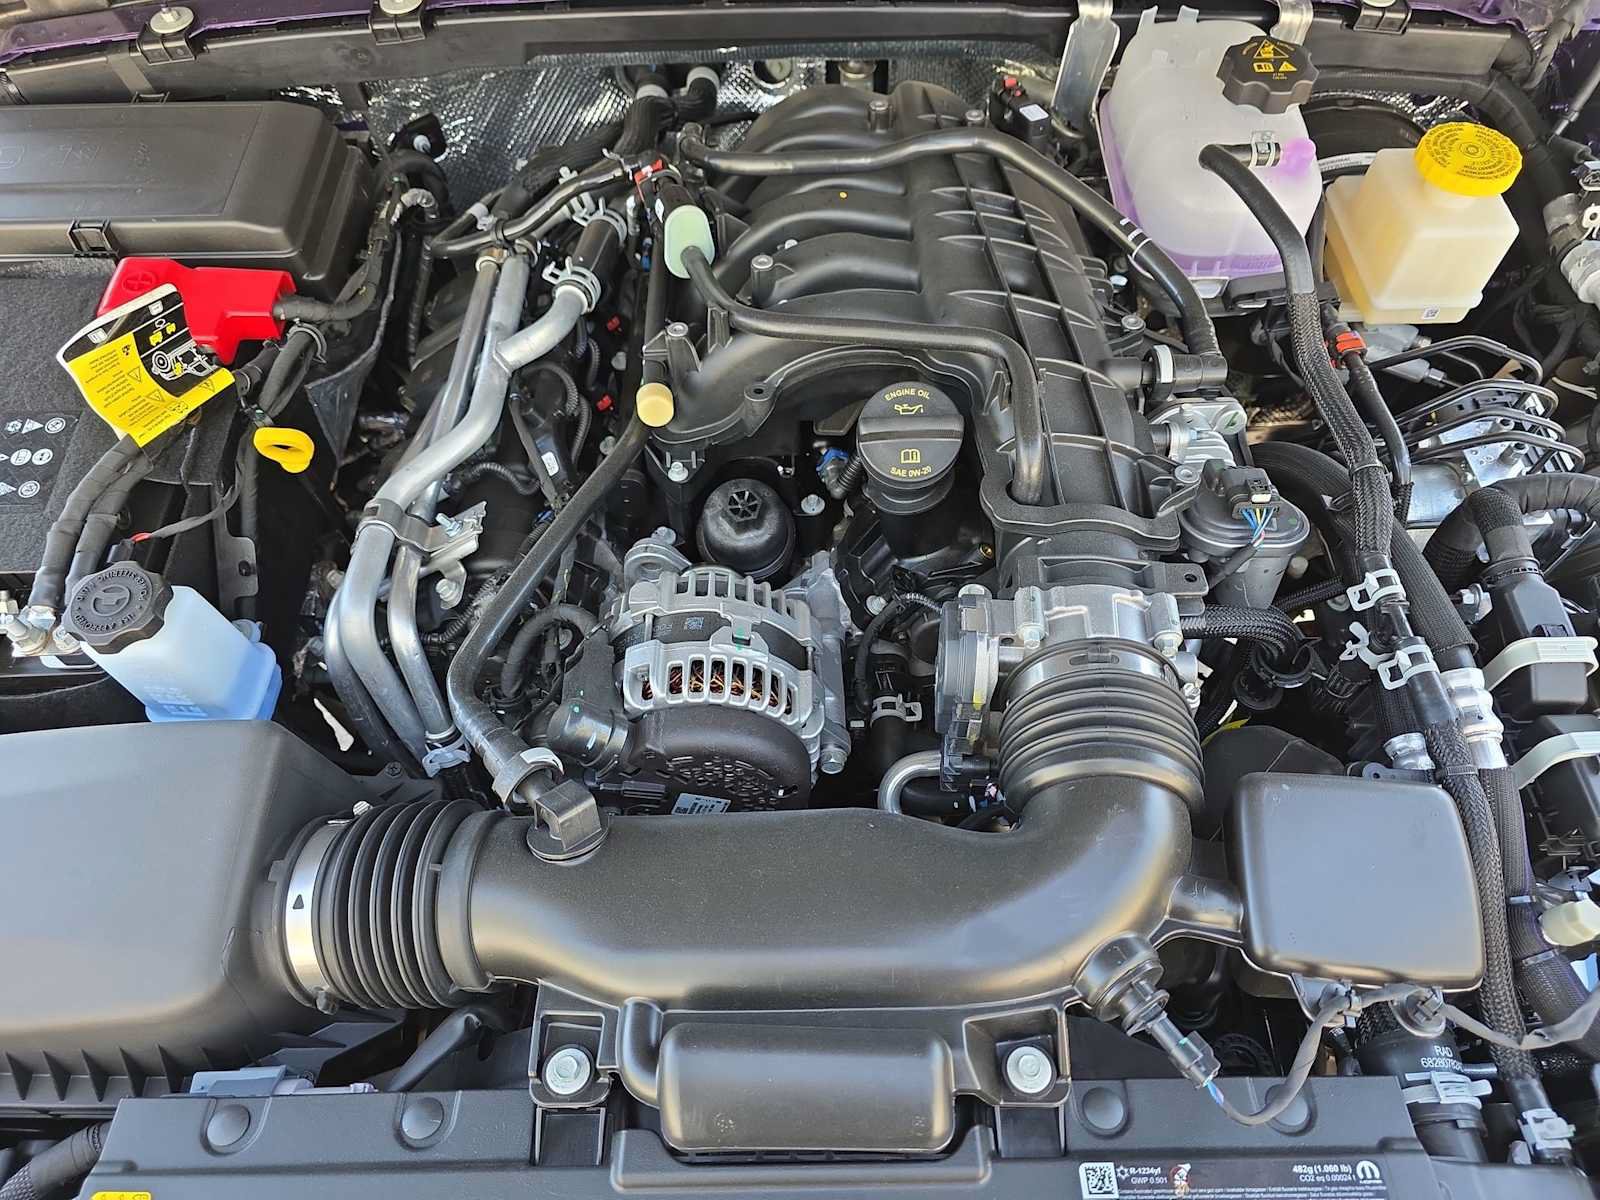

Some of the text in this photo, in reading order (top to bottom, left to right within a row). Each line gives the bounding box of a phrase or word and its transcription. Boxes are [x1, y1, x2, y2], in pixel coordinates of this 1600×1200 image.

[884, 388, 930, 401] ENGINE OIL
[890, 465, 932, 477] SAE 0W-20
[1434, 1045, 1453, 1057] RAD
